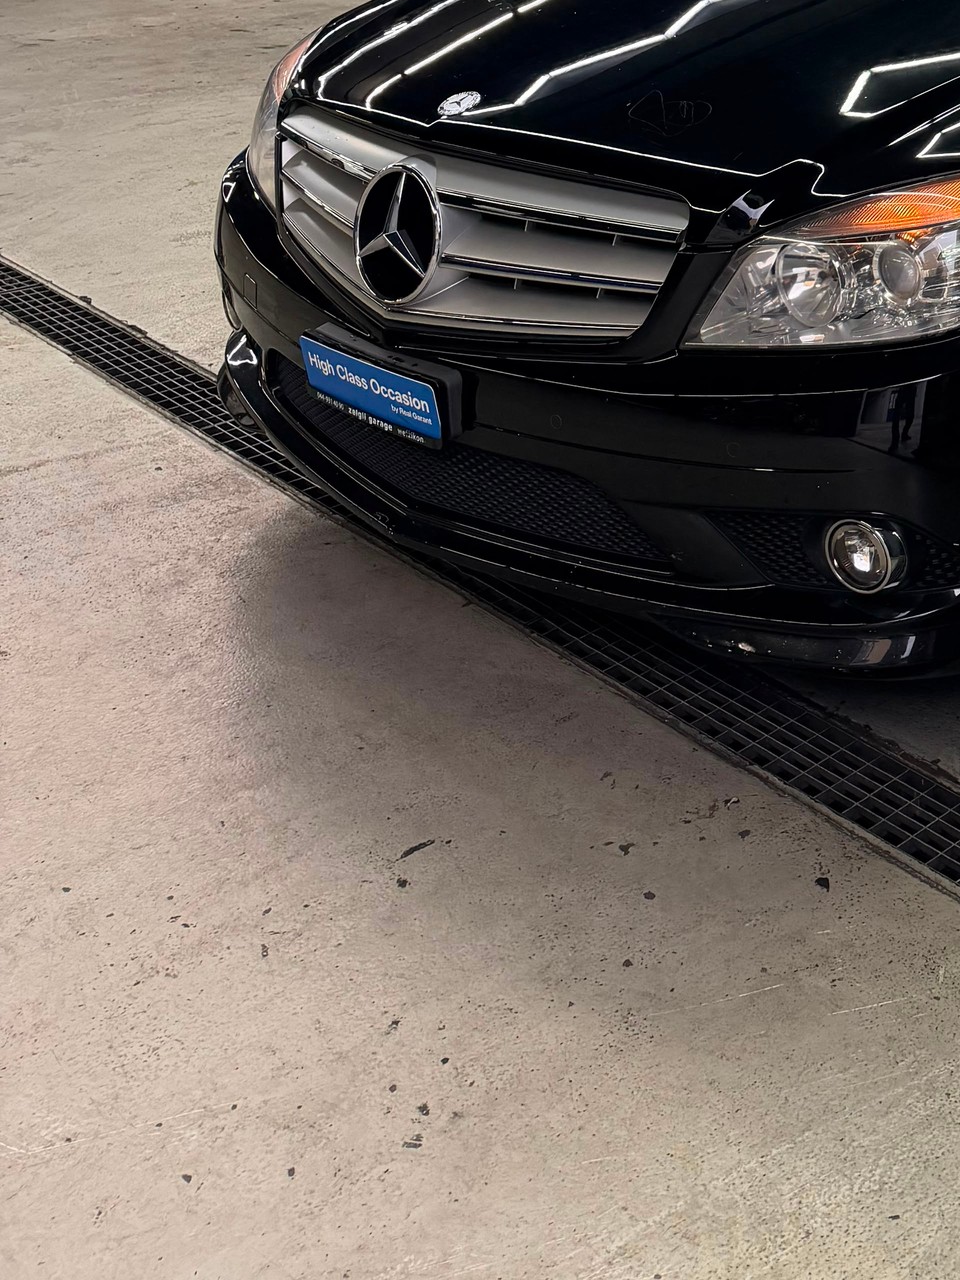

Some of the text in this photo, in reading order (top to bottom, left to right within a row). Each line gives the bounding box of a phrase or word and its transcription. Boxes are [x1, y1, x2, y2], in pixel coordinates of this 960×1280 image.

[307, 351, 430, 414] High Class Occasion
[368, 415, 393, 432] garage
[391, 404, 399, 414] by
[412, 411, 433, 426] Garant
